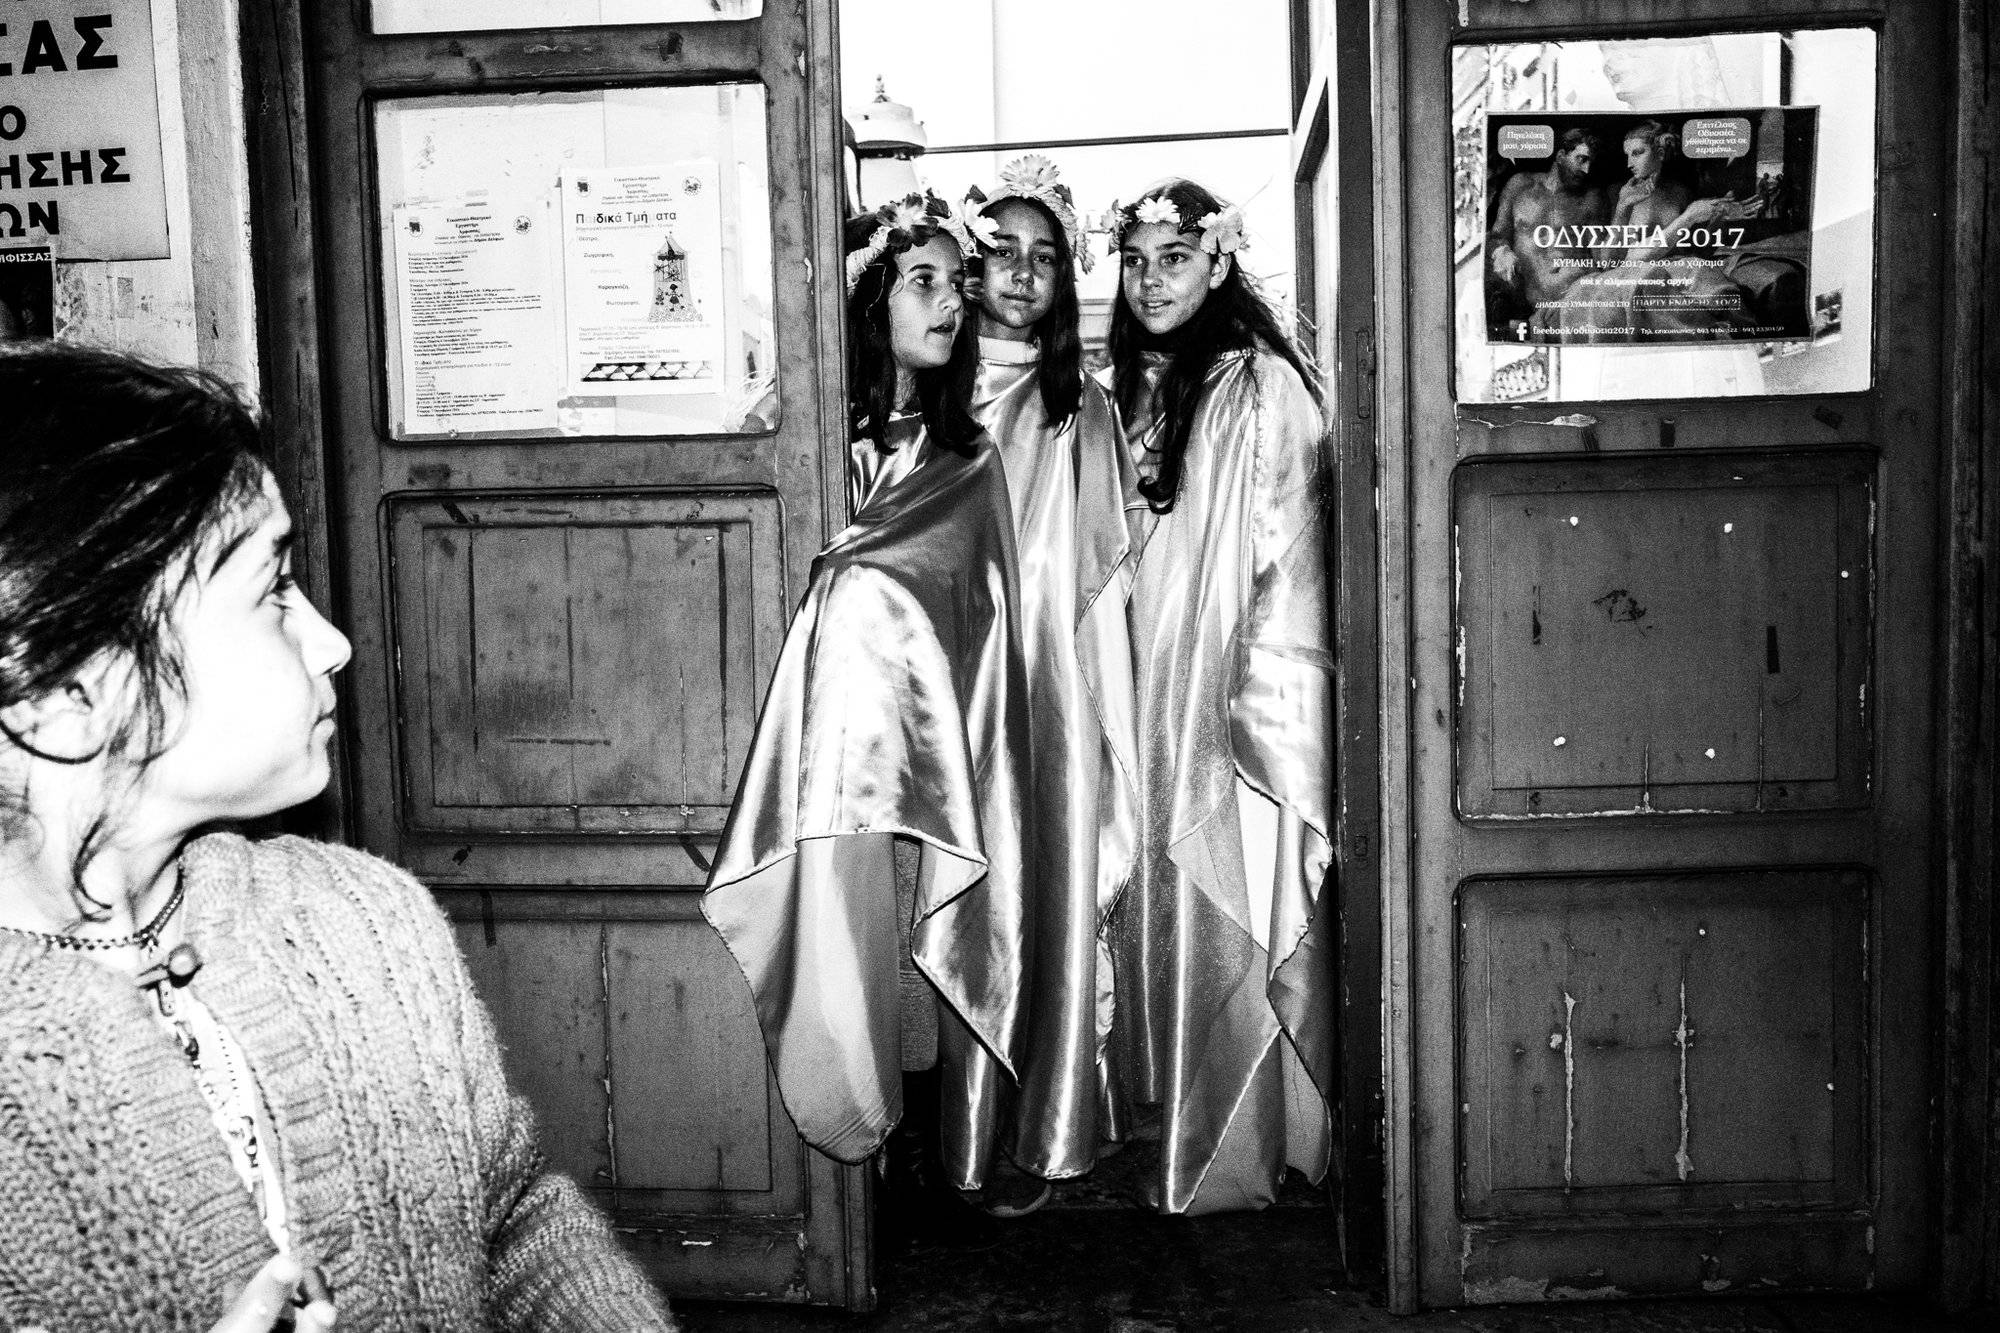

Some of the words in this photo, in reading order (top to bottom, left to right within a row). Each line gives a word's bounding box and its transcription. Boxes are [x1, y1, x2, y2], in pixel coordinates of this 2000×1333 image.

[0, 14, 119, 76] ΑΣ
[0, 200, 59, 238] ΩΝ
[576, 212, 622, 224] Πιδικά
[626, 210, 677, 224] Τμήατα
[1533, 224, 1669, 249] ΟΔΥΣΣΕΙΑ
[1676, 228, 1745, 250] 2017
[1553, 258, 1594, 268] ΚΥΡΙΑΚΗ
[1596, 259, 1644, 269] 19/2/2017
[1687, 257, 1724, 269] χάραμα
[1636, 298, 1665, 307] ΠΑΡΤΥ
